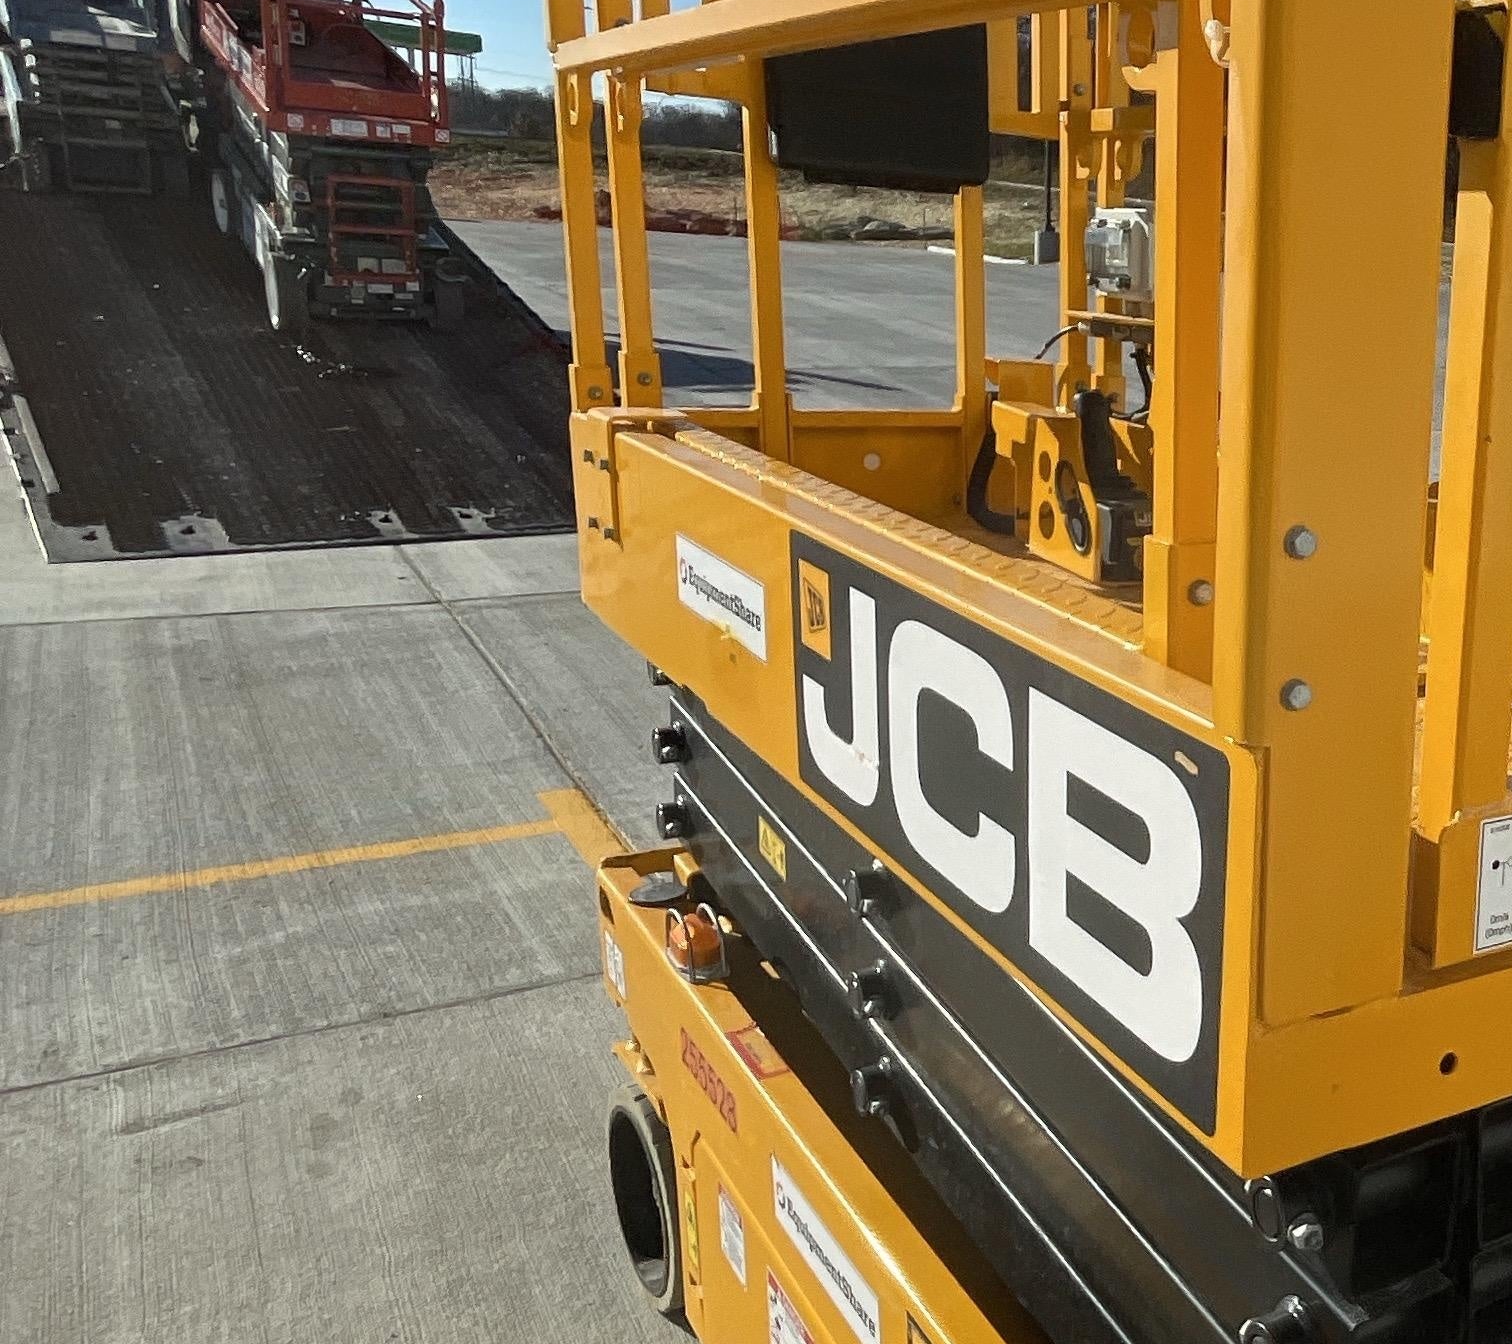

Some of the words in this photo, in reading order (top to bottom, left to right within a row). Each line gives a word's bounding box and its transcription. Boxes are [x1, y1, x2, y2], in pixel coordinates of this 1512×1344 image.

[688, 564, 762, 632] EquipmentShare
[802, 585, 1203, 1063] JCB
[786, 1197, 878, 1338] EquipmentShare
